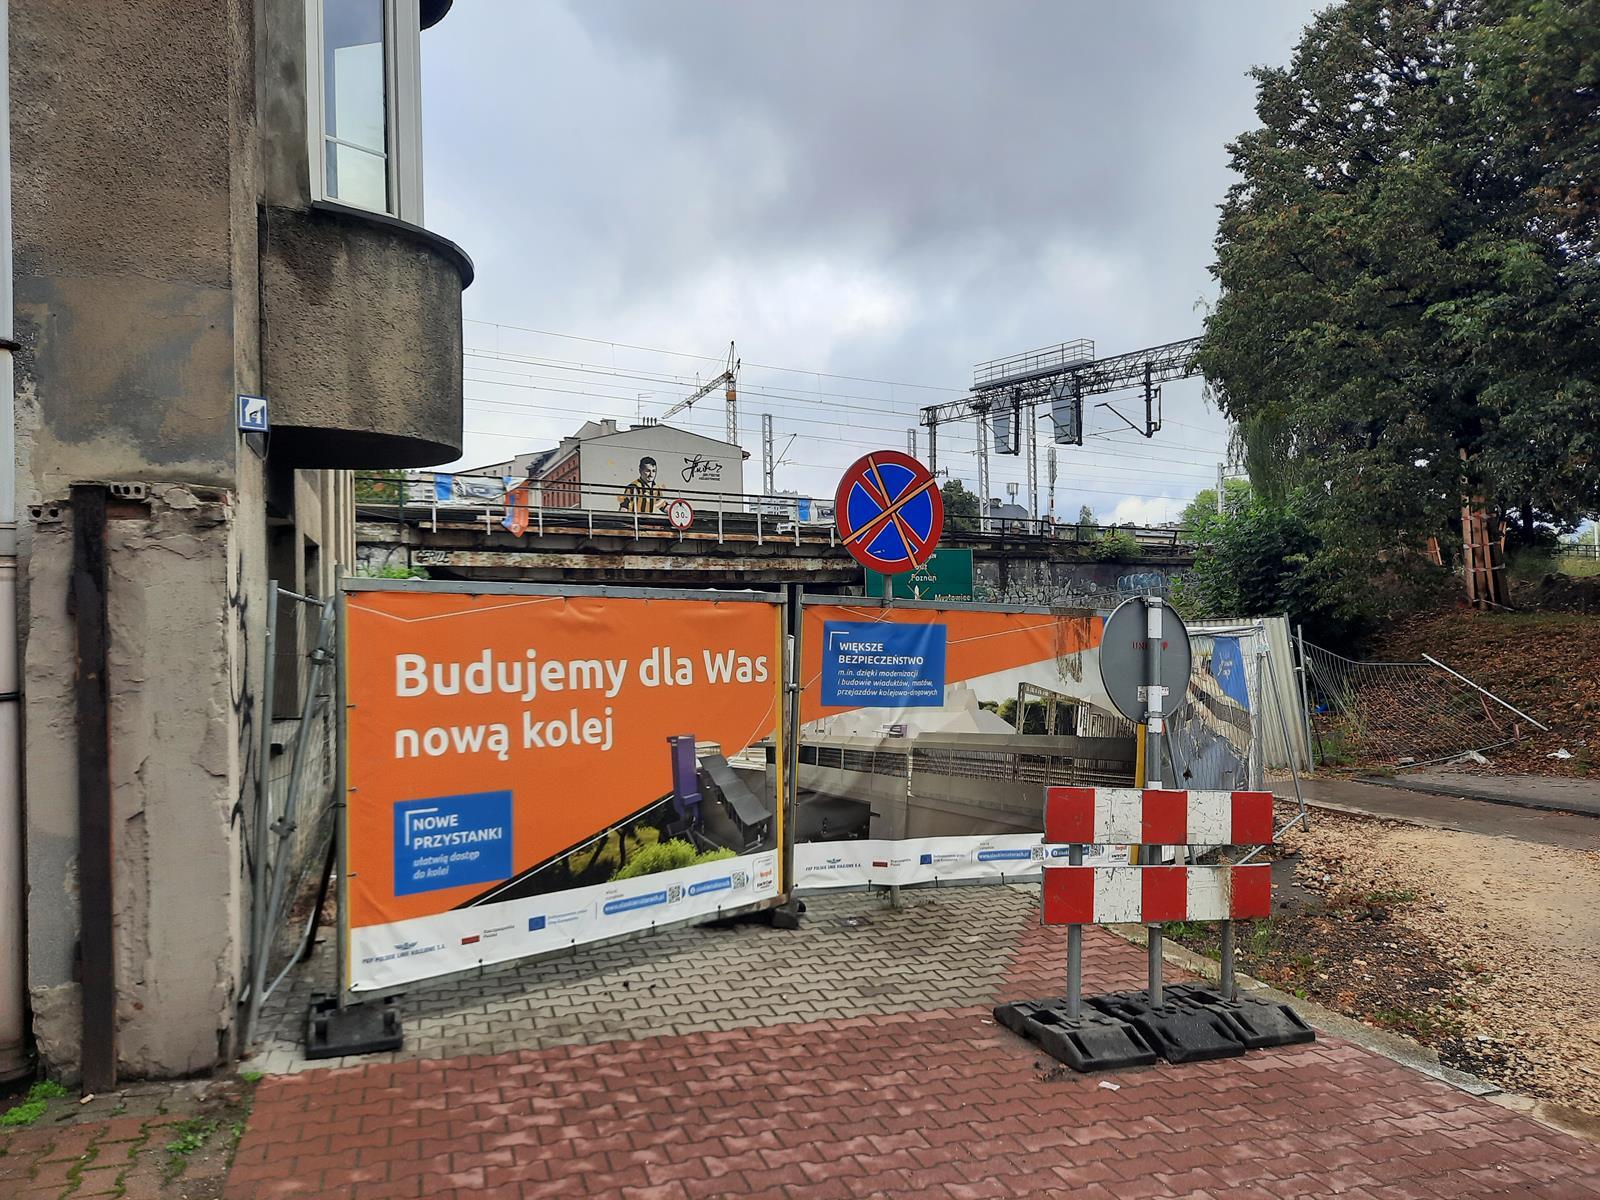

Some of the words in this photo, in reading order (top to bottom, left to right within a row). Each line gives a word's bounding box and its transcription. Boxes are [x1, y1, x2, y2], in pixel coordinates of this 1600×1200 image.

[839, 642, 884, 653] WIĘKSZE
[838, 654, 924, 665] BEZPIECZEŃSTWO
[395, 648, 627, 702] Budujemy
[638, 647, 693, 687] dla
[703, 649, 769, 685] Was
[837, 669, 855, 677] m.in.
[856, 669, 878, 678] dzięki
[878, 670, 919, 679] modernizacji
[841, 678, 872, 686] budowie
[836, 688, 878, 697] przejazdów
[394, 721, 510, 762] nową
[522, 706, 615, 752] kolej
[413, 814, 459, 832] NOWE
[413, 827, 503, 850] PRZYSTANKI
[413, 869, 426, 880] do
